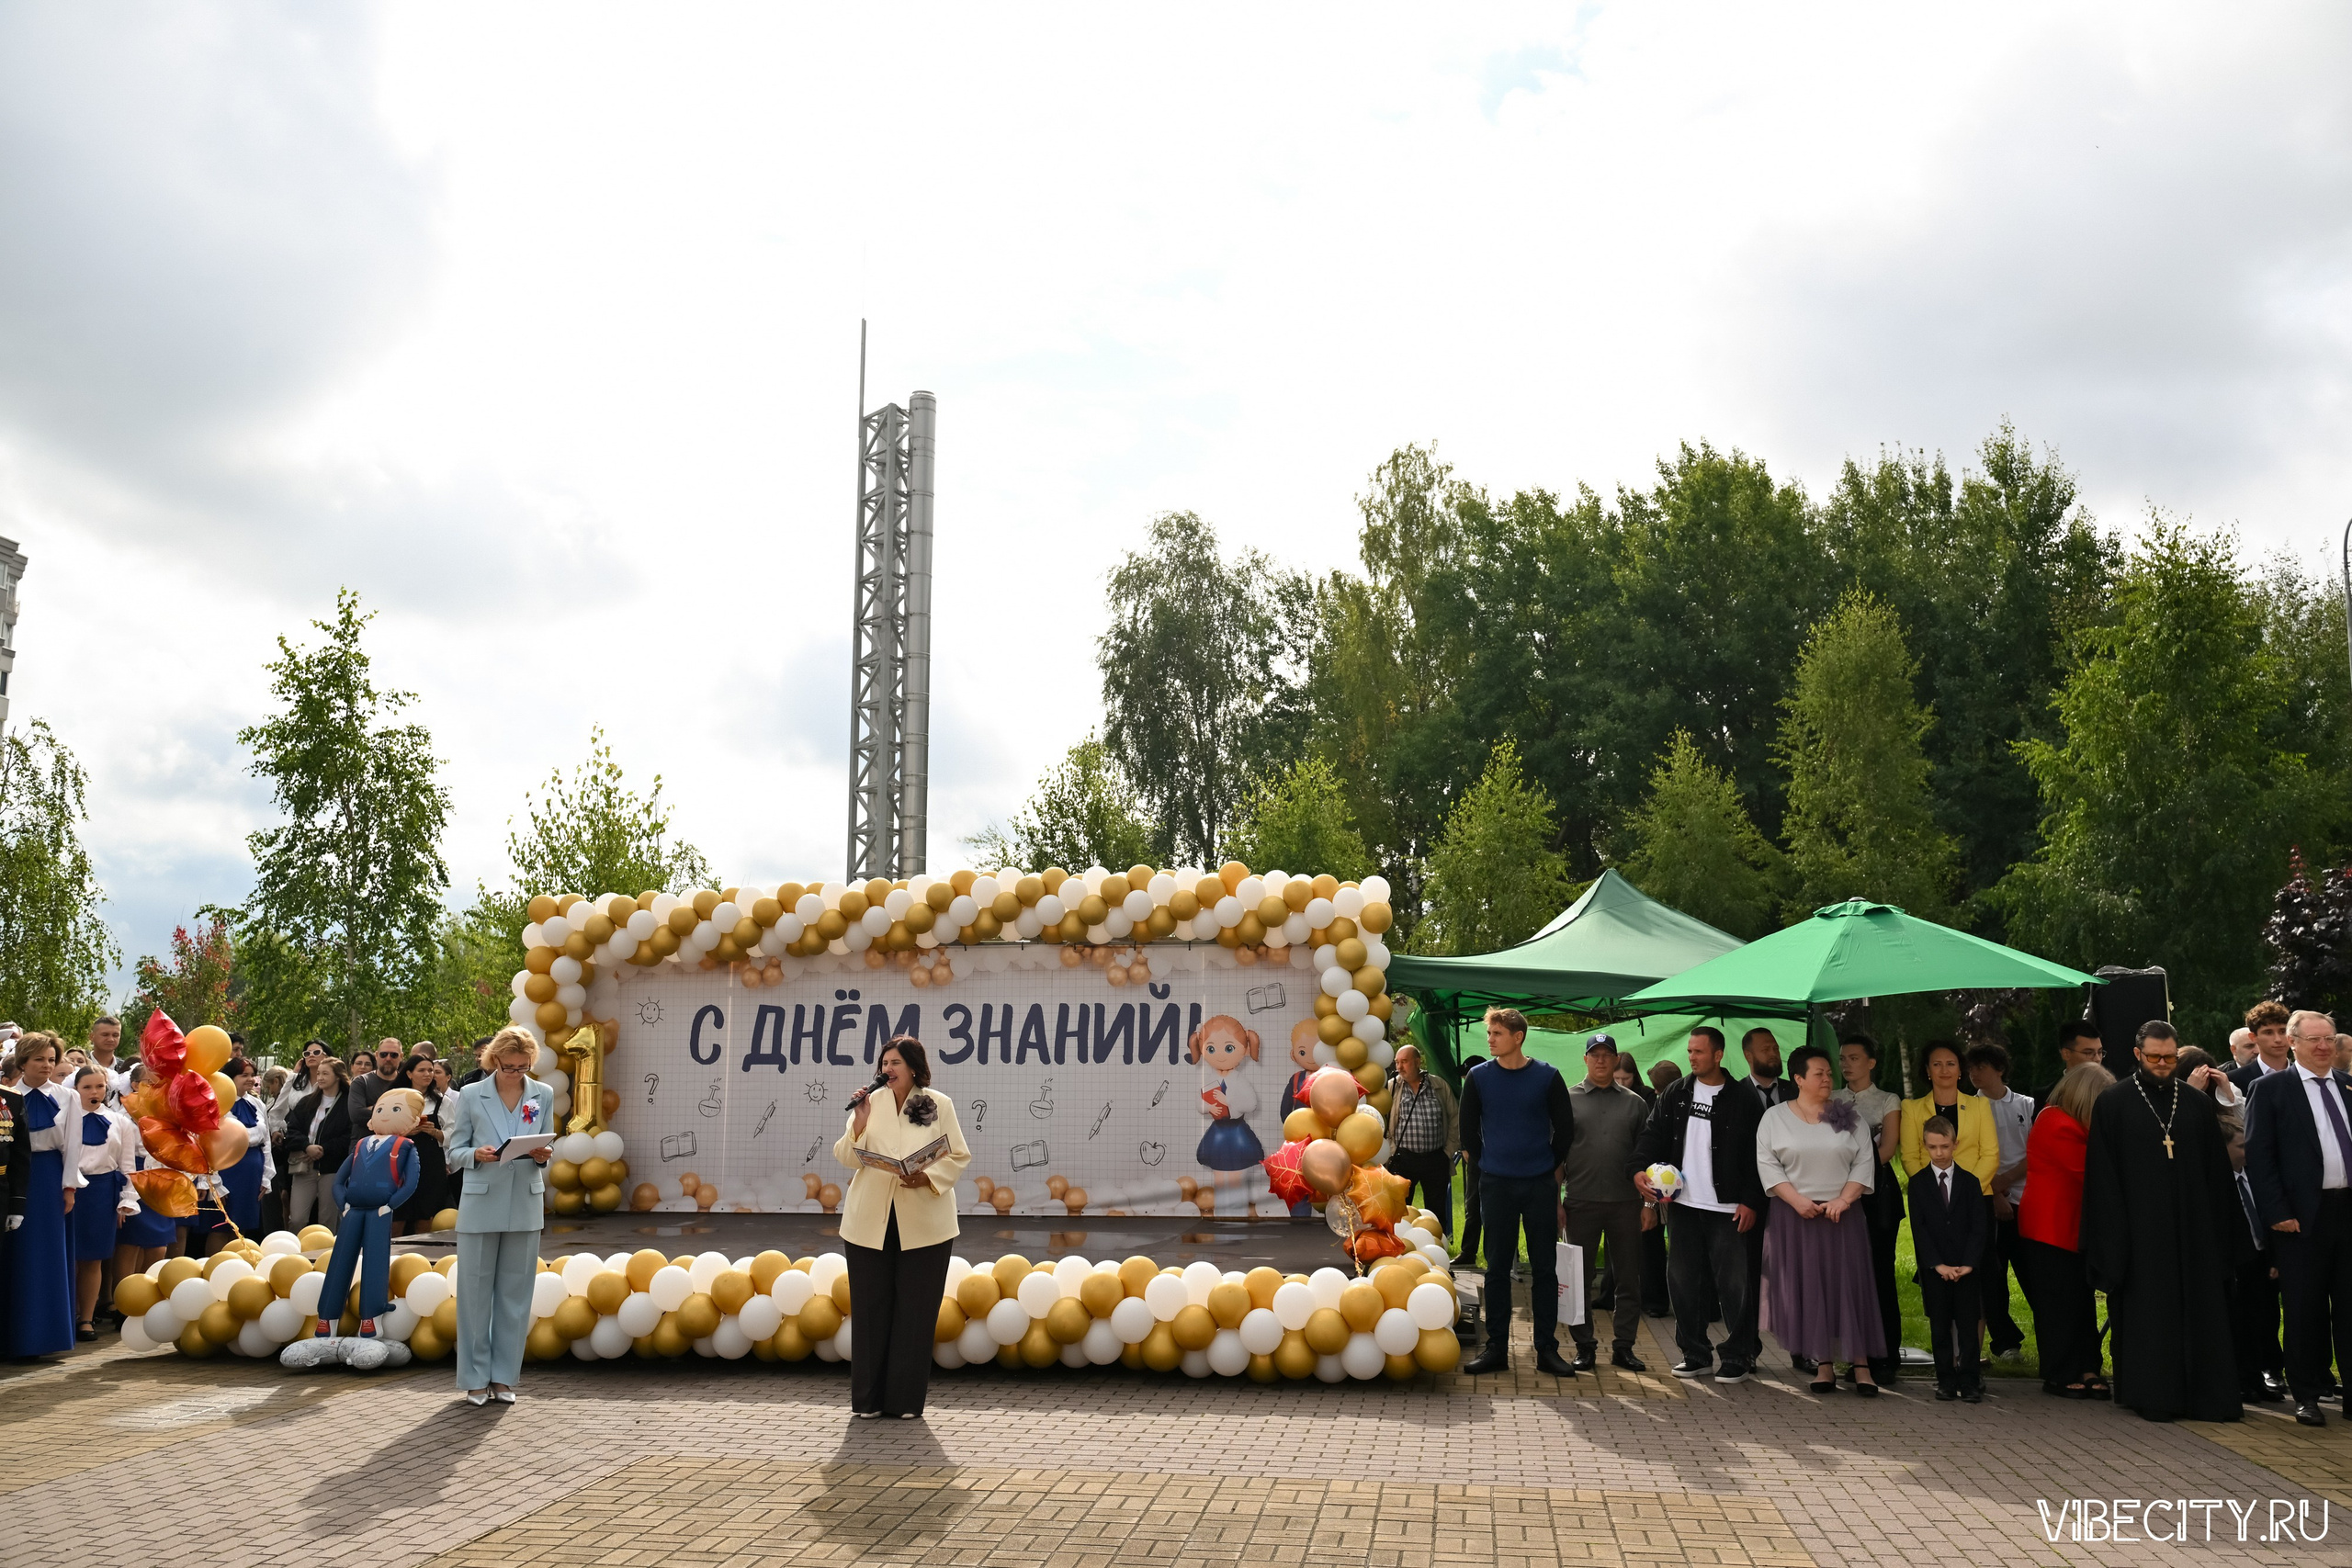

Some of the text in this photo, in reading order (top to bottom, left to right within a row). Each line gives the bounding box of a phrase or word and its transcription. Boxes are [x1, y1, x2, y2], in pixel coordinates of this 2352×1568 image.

[689, 983, 1202, 1075] С ДНЁМ ЗНАНИЙ!
